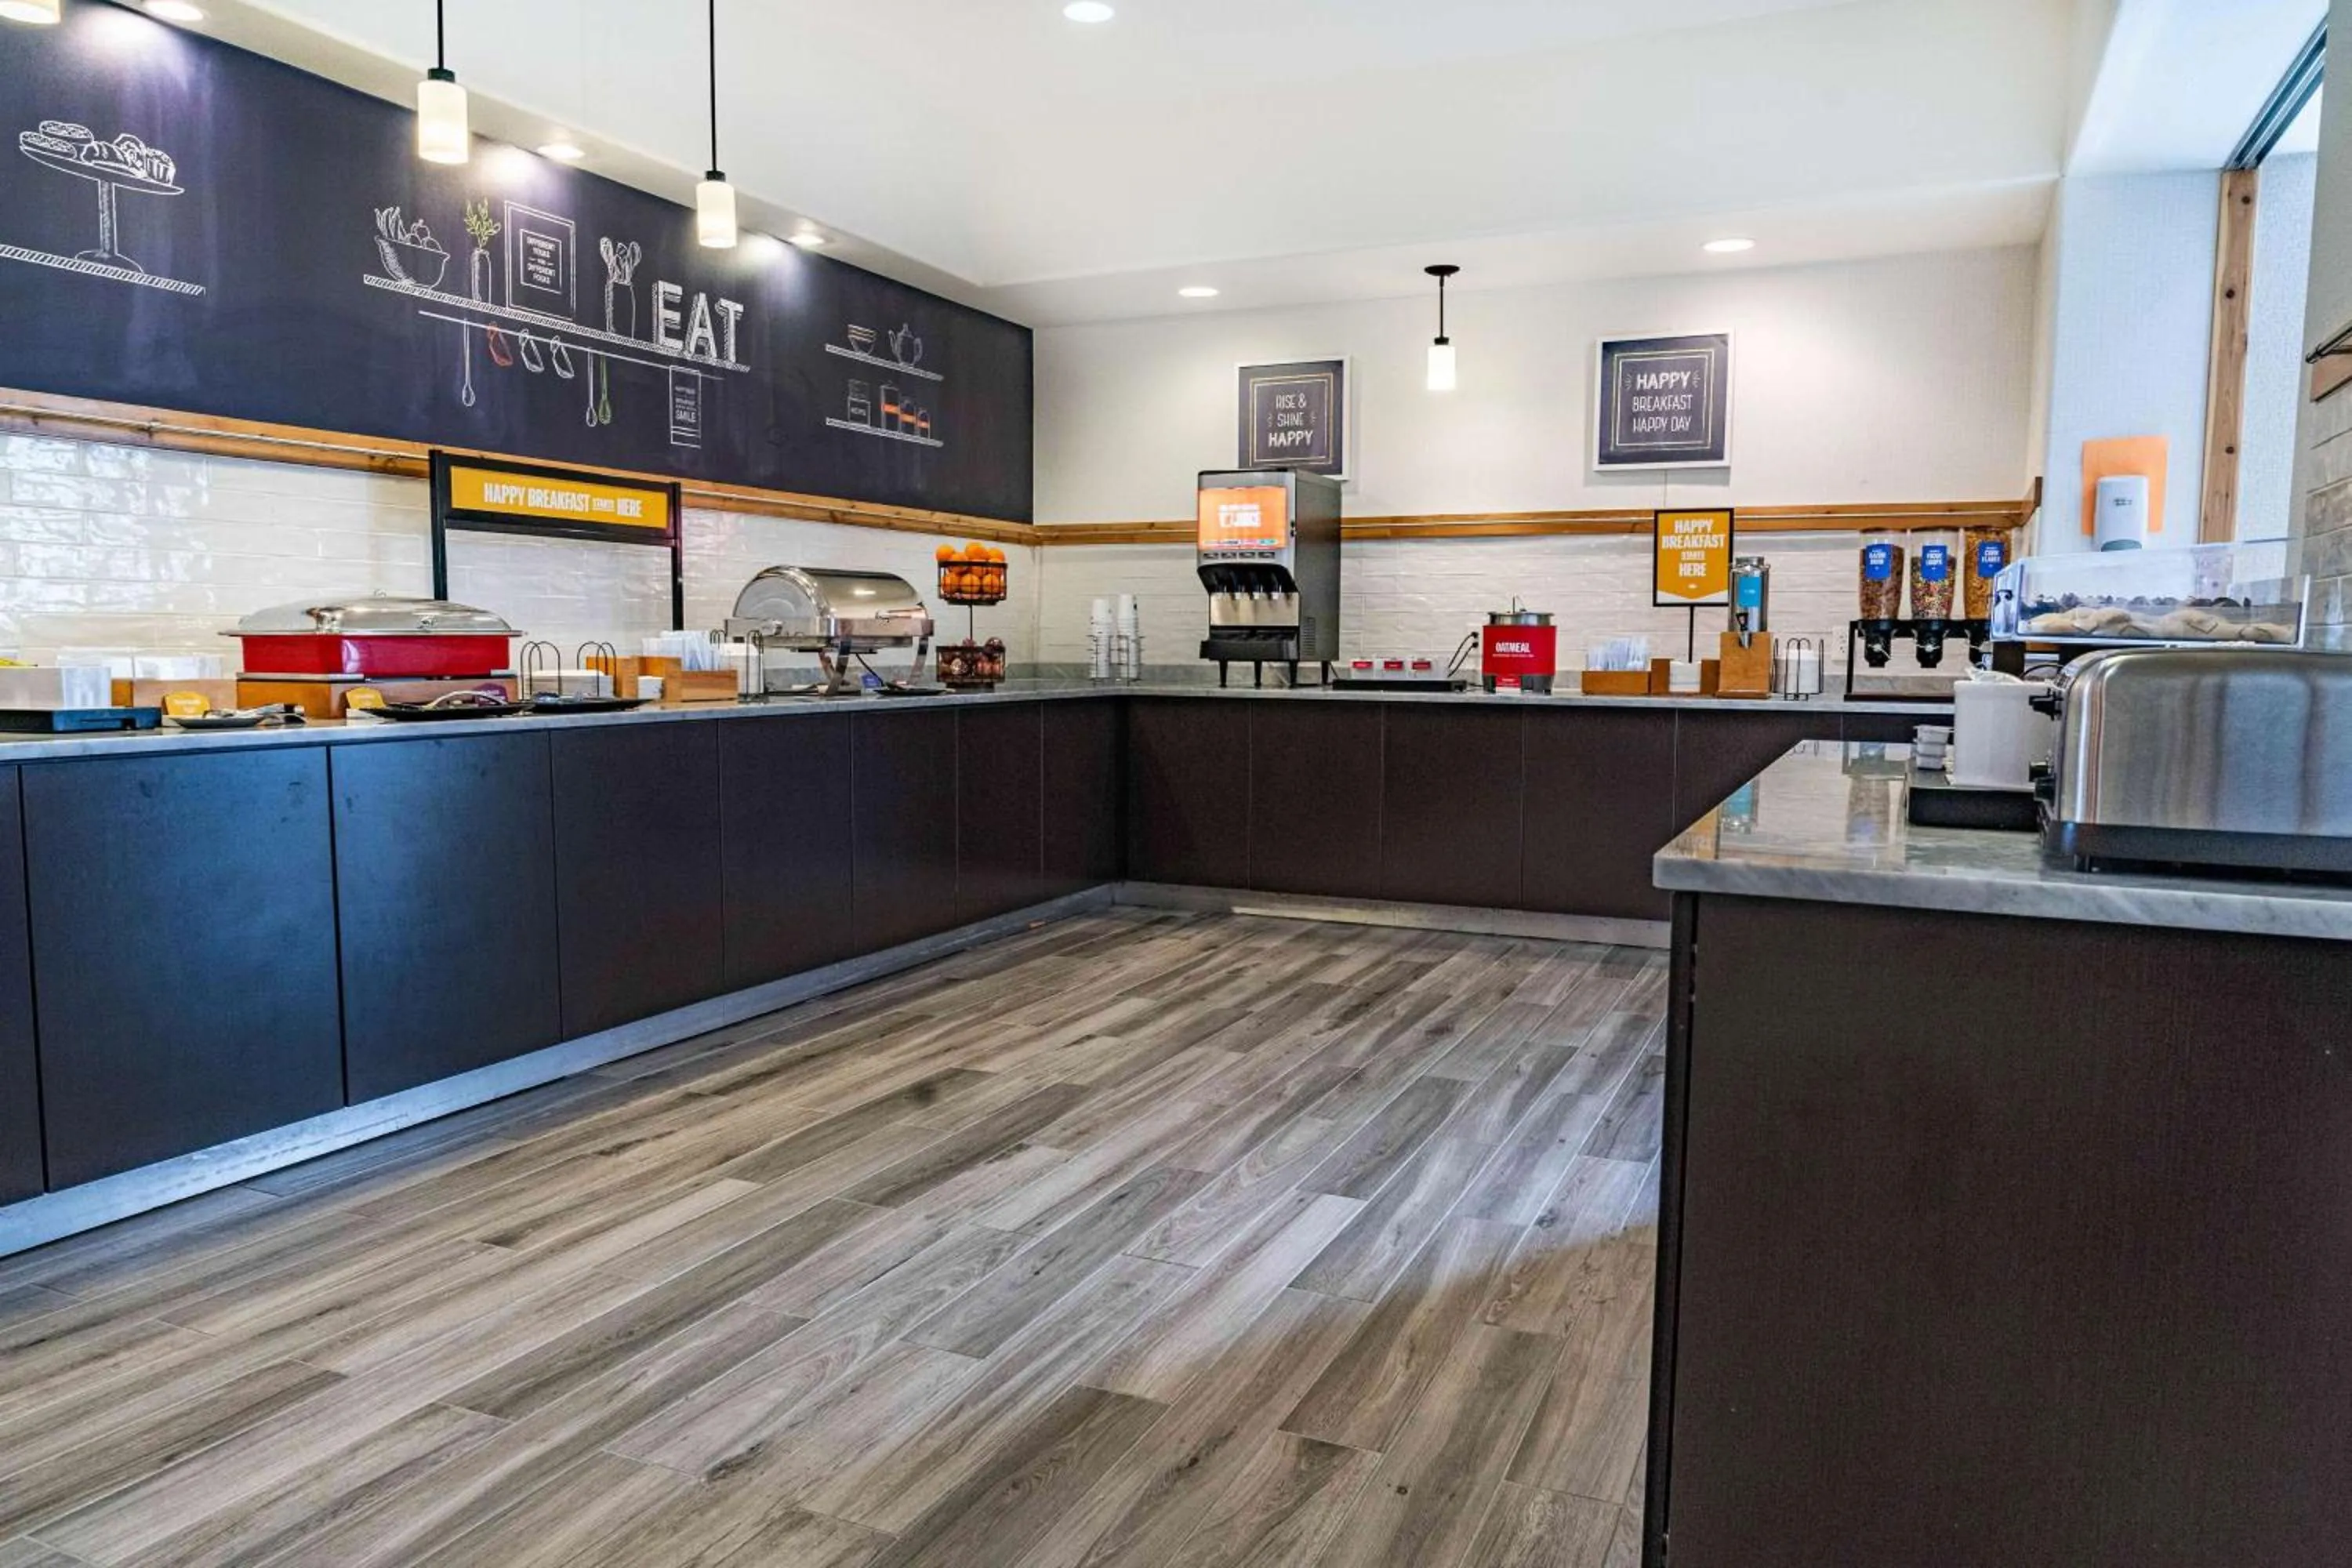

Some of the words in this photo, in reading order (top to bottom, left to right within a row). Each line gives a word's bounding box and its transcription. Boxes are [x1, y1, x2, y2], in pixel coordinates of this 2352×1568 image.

[652, 280, 744, 362] EAT
[1636, 371, 1691, 390] HAPPY
[1276, 394, 1296, 408] RISE
[1298, 392, 1307, 408] &
[1632, 394, 1693, 412] BREAKFAST
[1277, 412, 1304, 427] SHINE
[1633, 416, 1668, 433] HAPPY
[1671, 416, 1691, 432] DAY
[1268, 430, 1314, 448] HAPPY
[484, 481, 526, 507] HAPPY
[527, 488, 591, 513] BREAKFAST
[617, 497, 643, 518] HERE
[1674, 518, 1715, 534] HAPPY
[1661, 534, 1726, 549] BREAKFAST
[1679, 563, 1707, 577] HERE
[1495, 642, 1531, 653] OATMEAL
